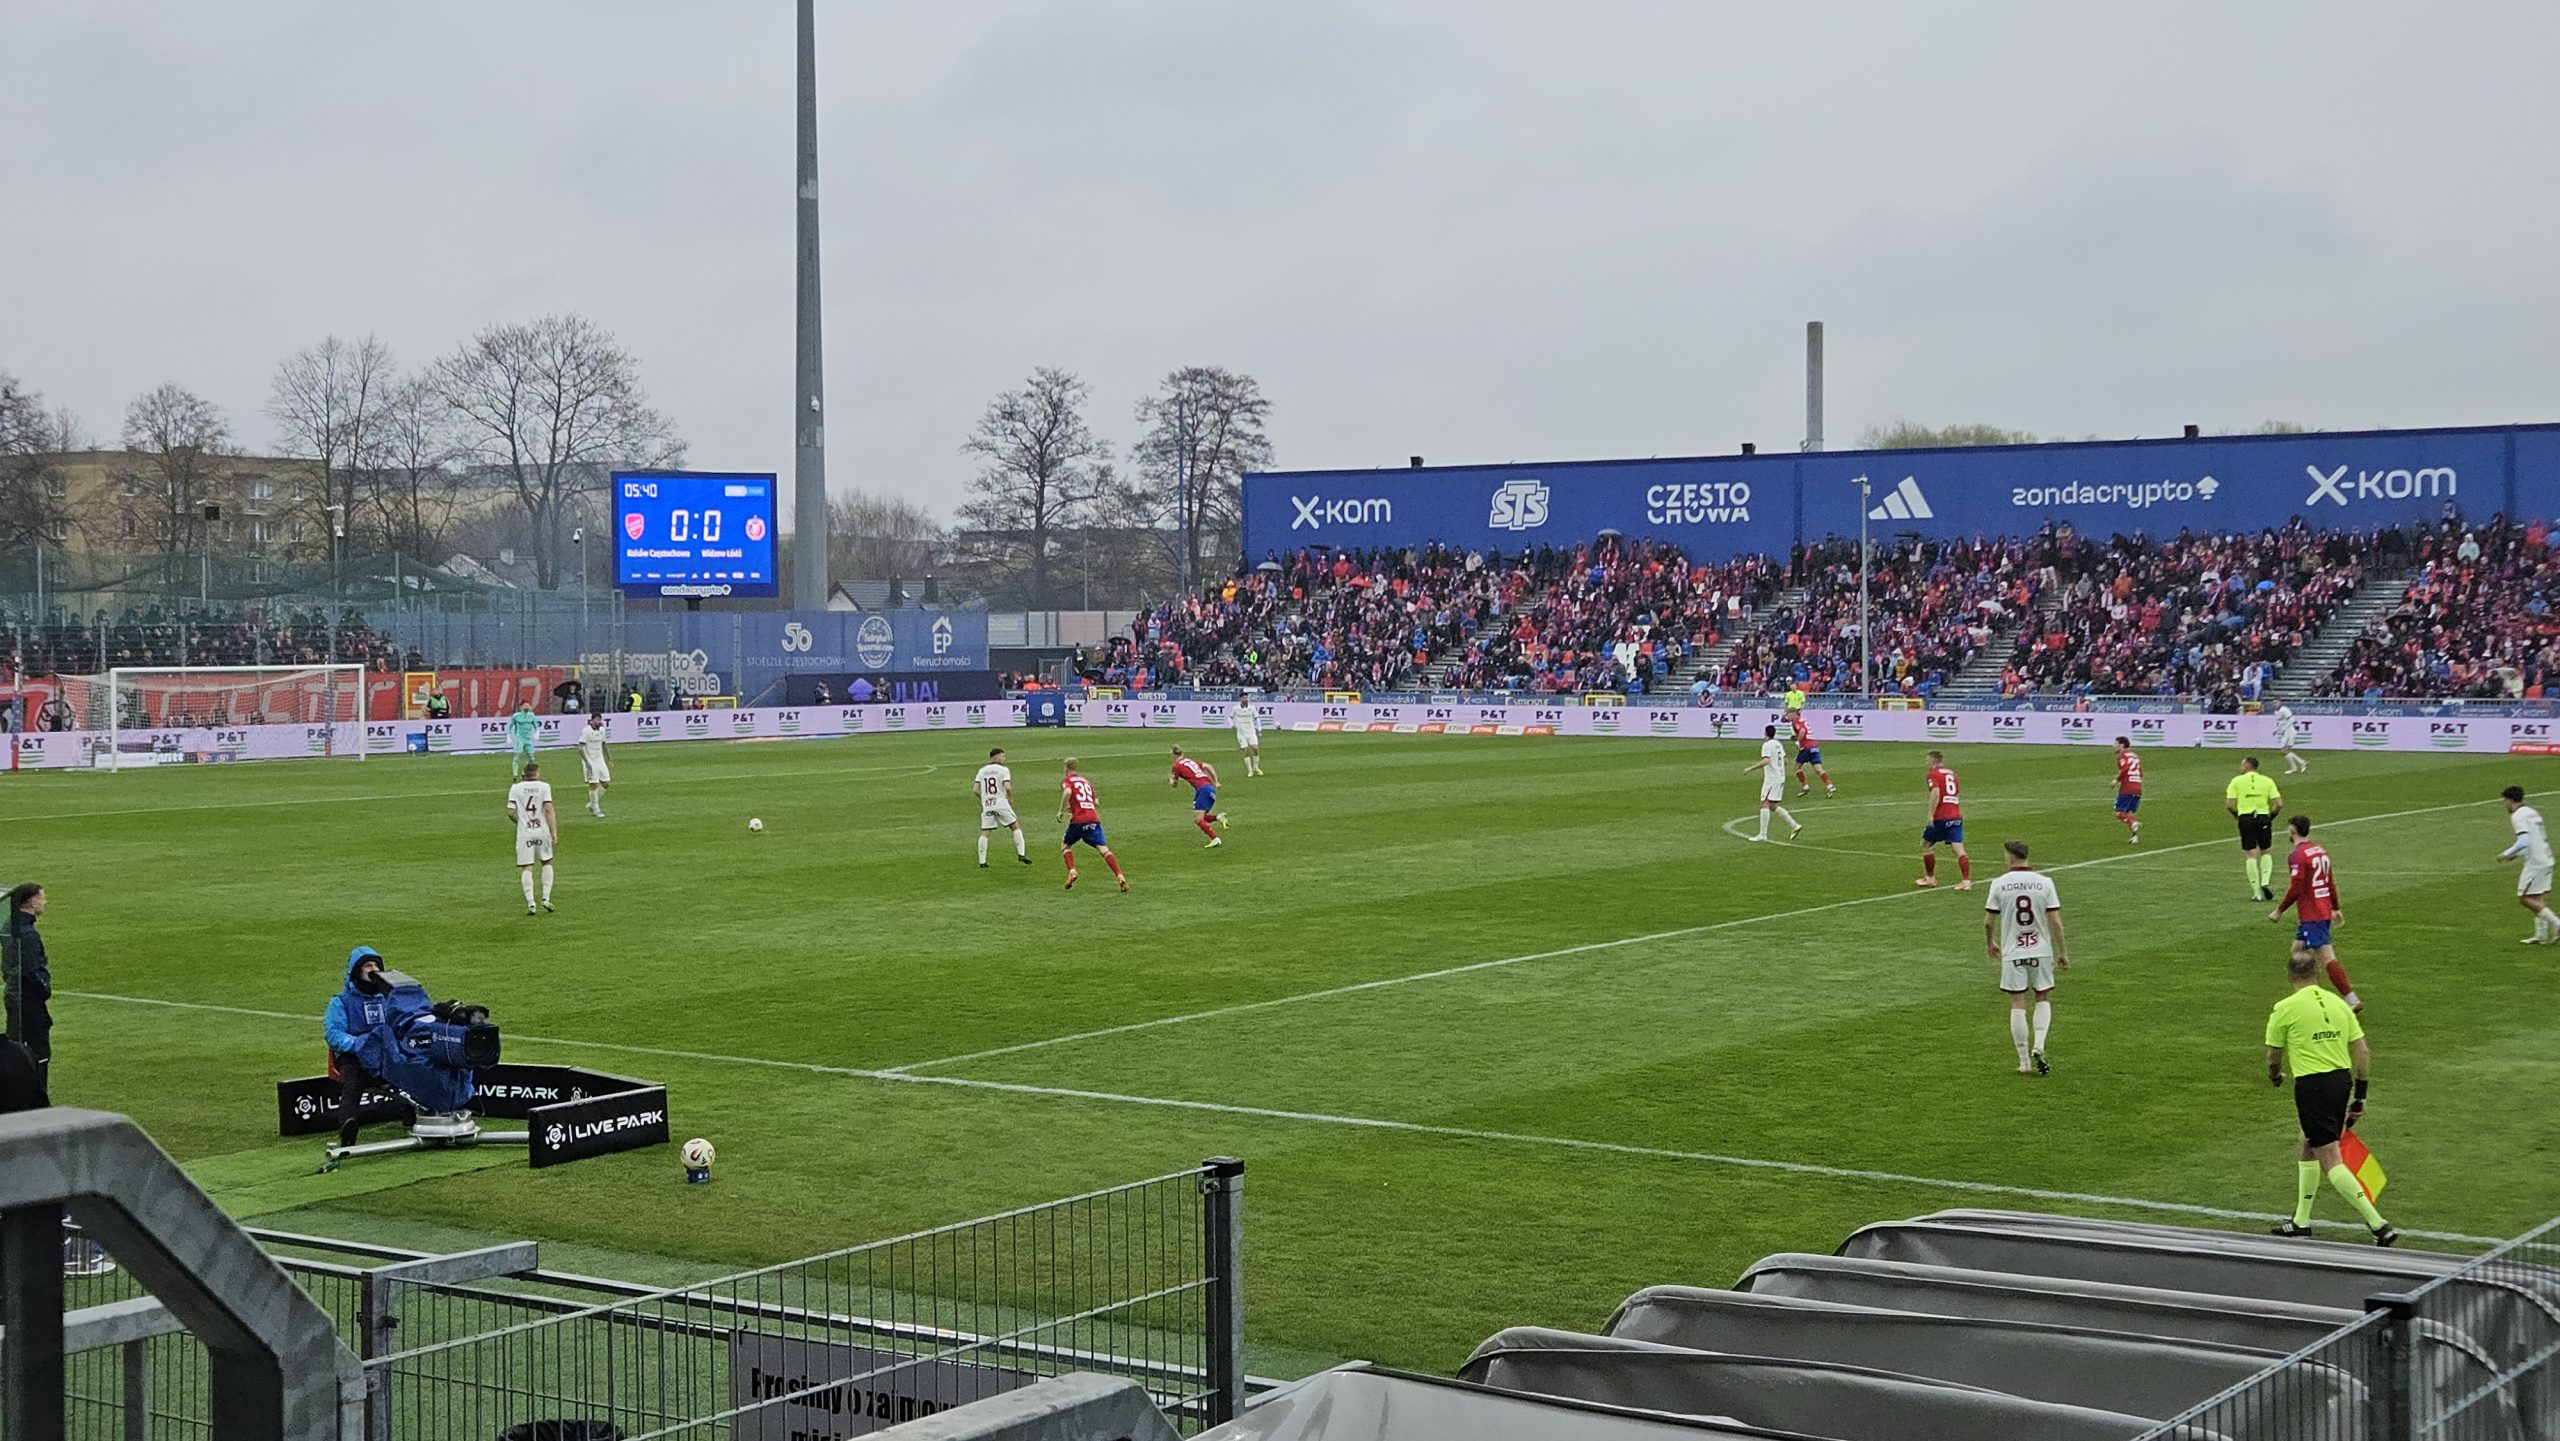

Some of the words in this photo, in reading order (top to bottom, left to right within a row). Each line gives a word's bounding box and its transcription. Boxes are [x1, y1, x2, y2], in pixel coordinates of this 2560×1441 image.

[625, 484, 657, 497] 05:40
[2012, 478, 2193, 508] zondacrypto
[1488, 480, 1549, 530] STS
[671, 509, 721, 541] 0:0
[933, 634, 951, 654] EP
[886, 708, 905, 717] P&T
[926, 706, 946, 716] P&T
[967, 705, 986, 714] P&T
[1106, 704, 1129, 712] P&T
[1154, 705, 1176, 714] P&T
[1202, 706, 1225, 714] P&T
[1323, 708, 1347, 716] P&T
[1374, 708, 1400, 717] P&T
[733, 713, 755, 722] P&T
[779, 712, 800, 721] P&T
[843, 710, 863, 718] P&T
[1427, 709, 1452, 718] P&T
[1481, 710, 1507, 718] P&T
[1536, 711, 1563, 720] P&T
[1592, 711, 1620, 720] P&T
[1650, 712, 1678, 721] P&T
[1710, 713, 1739, 722] P&T
[638, 717, 661, 726] P&T
[686, 714, 708, 724] P&T
[1833, 715, 1864, 724] P&T
[1926, 716, 1958, 726] P&T
[1993, 717, 2025, 726] P&T
[2061, 718, 2094, 728] P&T
[2131, 719, 2165, 729] P&T
[426, 724, 452, 734] P&T
[481, 723, 507, 732] P&T
[2203, 720, 2238, 730] P&T
[2353, 722, 2390, 732] P&T
[2430, 724, 2468, 734] P&T
[2511, 724, 2550, 735] P&T
[368, 726, 395, 736] P&T
[217, 732, 247, 742] P&T
[984, 778, 997, 795] 18
[1945, 773, 1957, 795] 6
[1074, 781, 1093, 802] 39
[525, 795, 537, 815] 4
[2312, 855, 2330, 887] 20
[2016, 895, 2034, 926] 8
[2017, 931, 2039, 947] STS
[510, 1087, 559, 1100] PARK
[575, 1119, 614, 1139] LIVE
[617, 1110, 663, 1128] PARK
[751, 1367, 843, 1415] Prosimy
[847, 1388, 862, 1415] o
